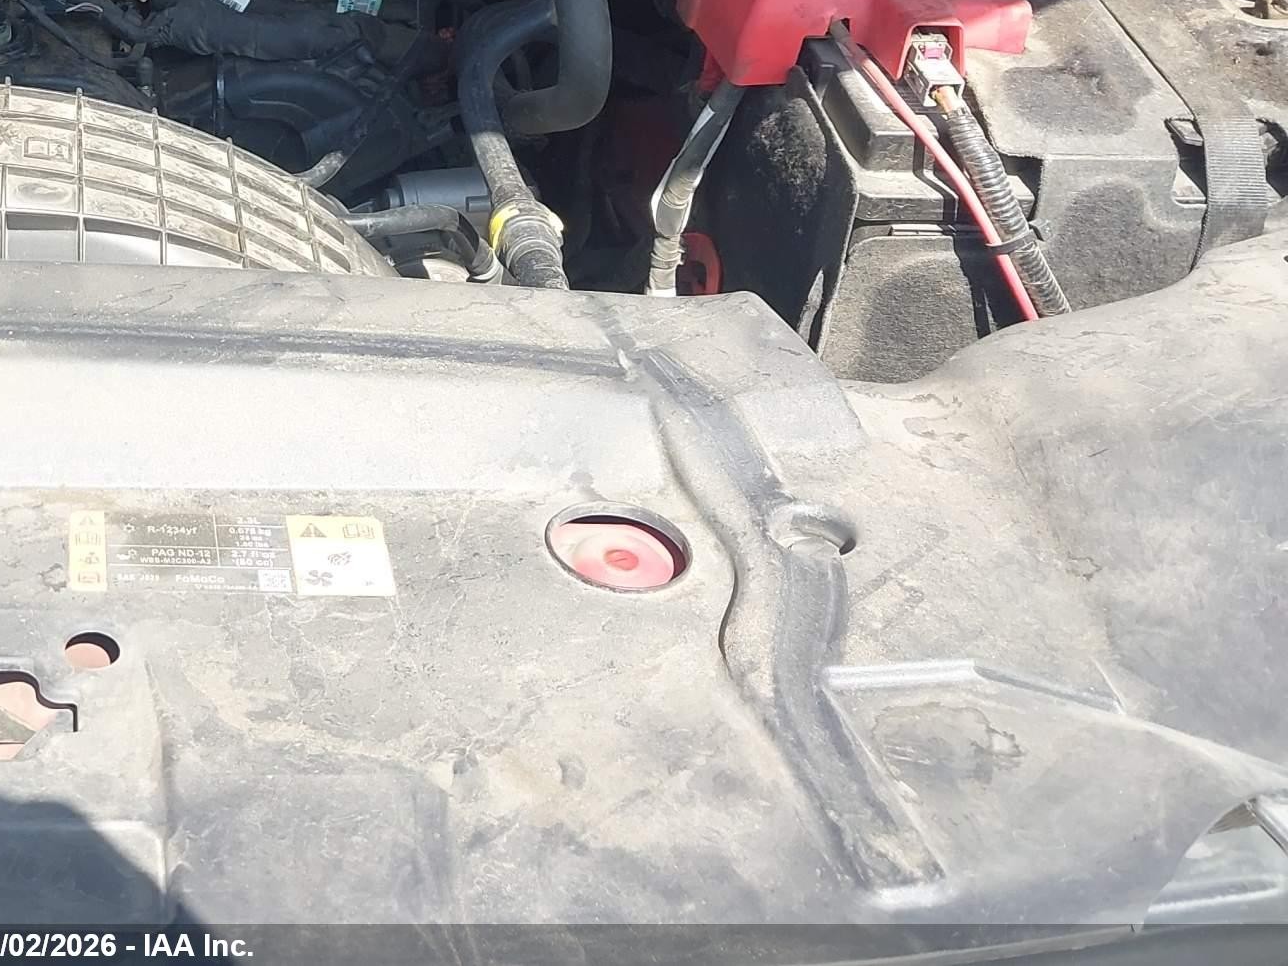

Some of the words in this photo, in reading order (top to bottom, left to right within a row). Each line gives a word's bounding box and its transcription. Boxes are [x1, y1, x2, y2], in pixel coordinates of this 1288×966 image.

[147, 524, 197, 535] R-1234yf
[151, 548, 175, 557] PAG
[178, 549, 211, 558] ND-12
[175, 574, 225, 583] FoMoCo
